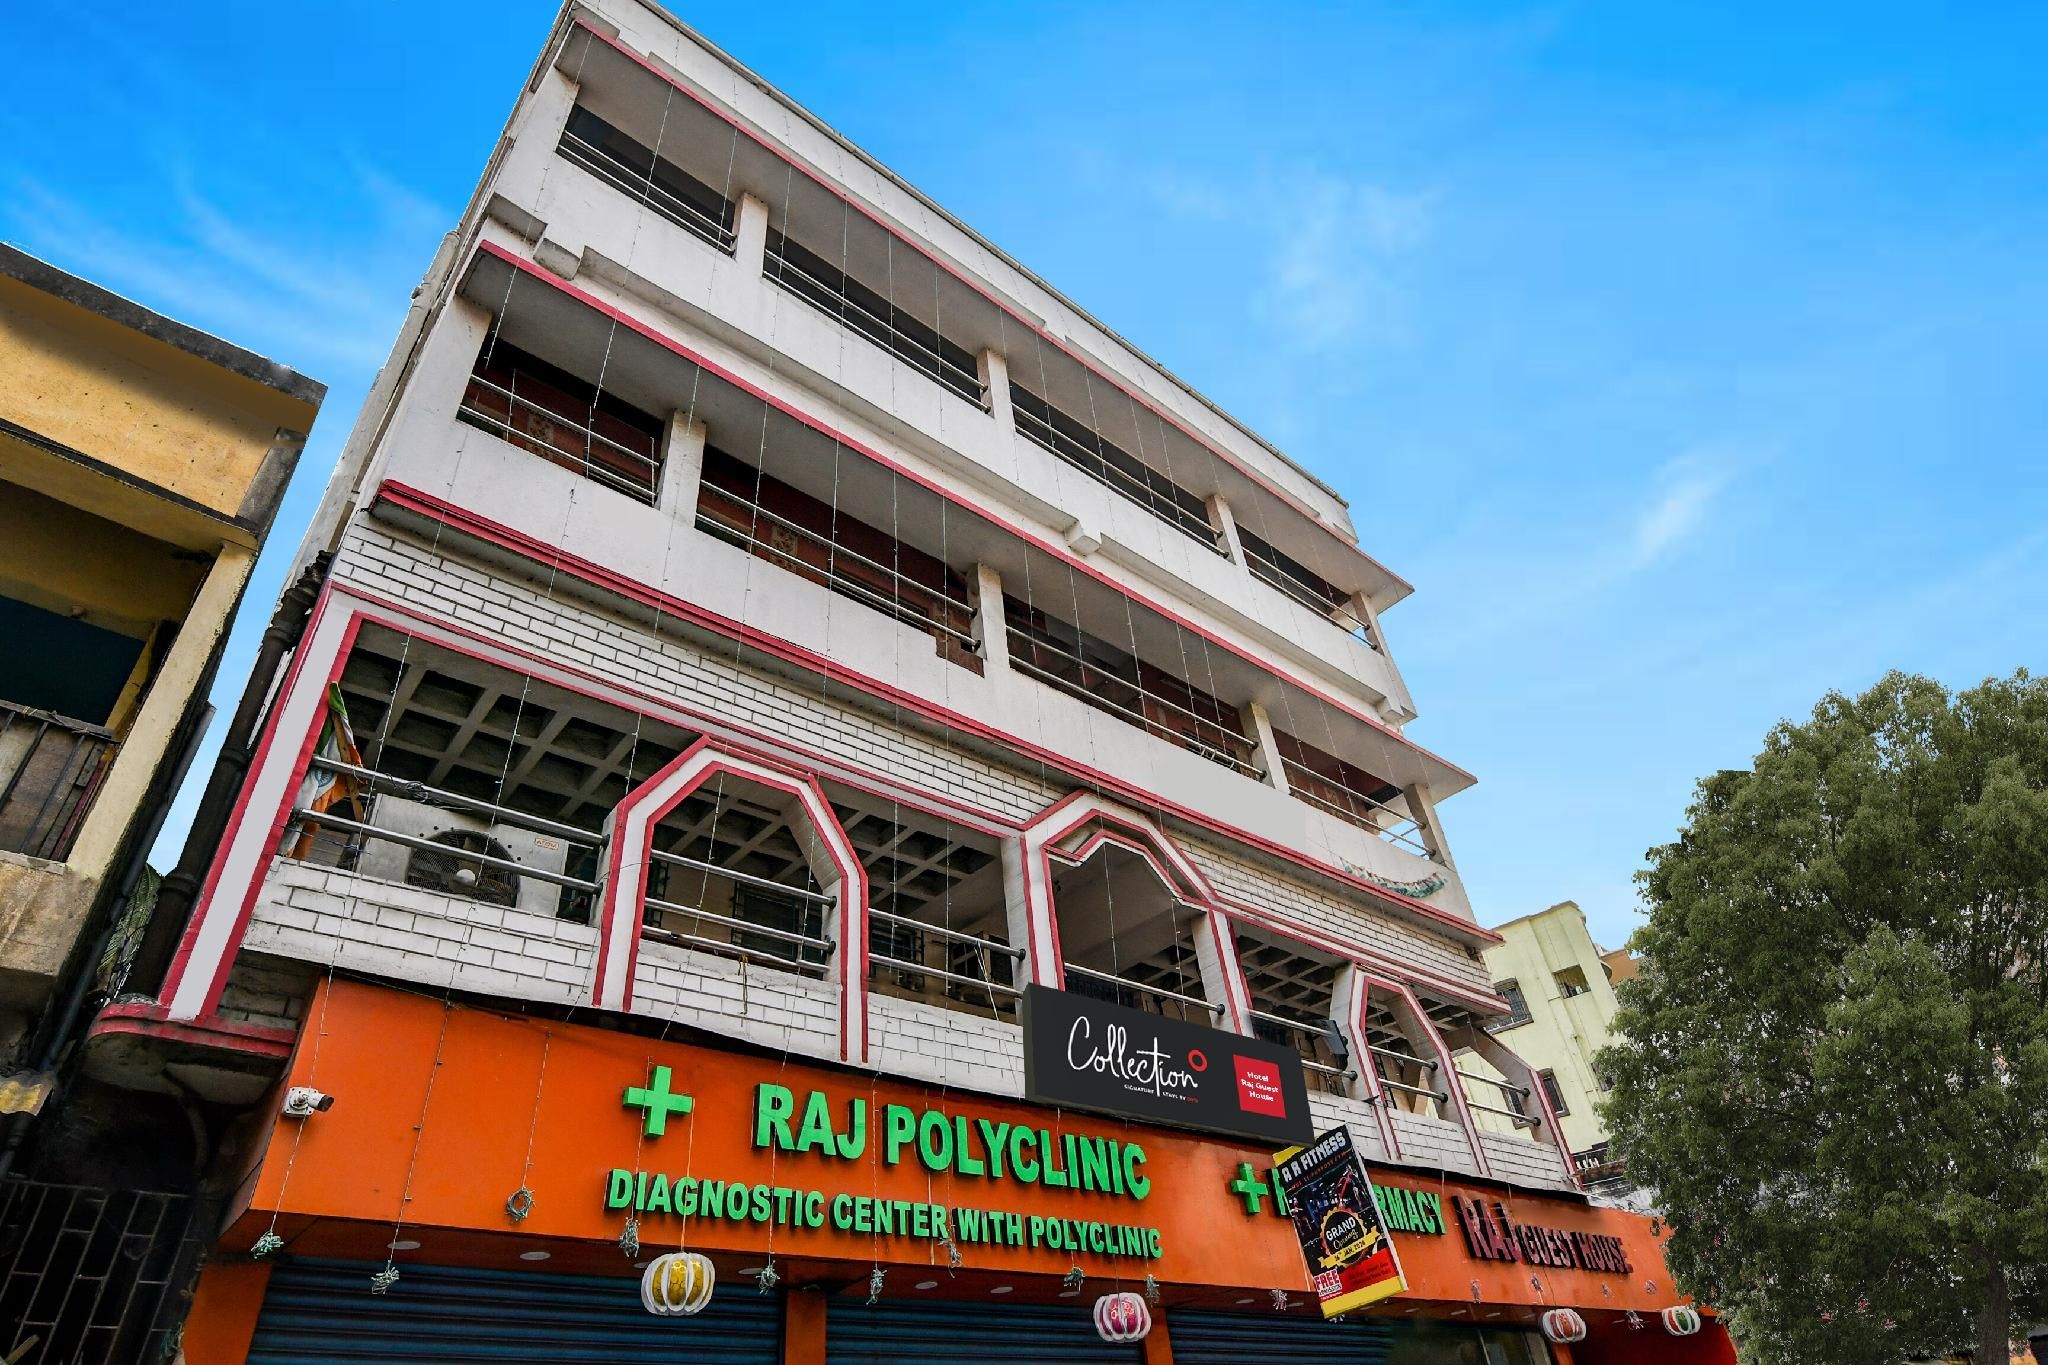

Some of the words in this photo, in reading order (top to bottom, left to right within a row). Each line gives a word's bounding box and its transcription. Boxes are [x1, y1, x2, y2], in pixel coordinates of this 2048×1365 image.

[1067, 1016, 1198, 1097] Collection
[1241, 1078, 1254, 1089] Raj
[1255, 1082, 1279, 1093] Guest
[1246, 1071, 1269, 1082] Hotel
[1248, 1090, 1274, 1102] House
[754, 1083, 867, 1160] RAJ
[882, 1103, 1152, 1201] POLYCLINIC
[1300, 1131, 1347, 1171] FITNESS
[606, 1168, 825, 1229] DIAGNOSTIC
[833, 1193, 948, 1239] CENTER
[956, 1207, 1024, 1247] WITH
[1031, 1215, 1163, 1260] POLYCLINIC
[1325, 1216, 1356, 1241] GRAND
[1453, 1196, 1522, 1262] RAJ
[1518, 1225, 1580, 1268] GUEST
[1574, 1232, 1634, 1274] HOUSE
[1313, 1269, 1340, 1291] FREE
